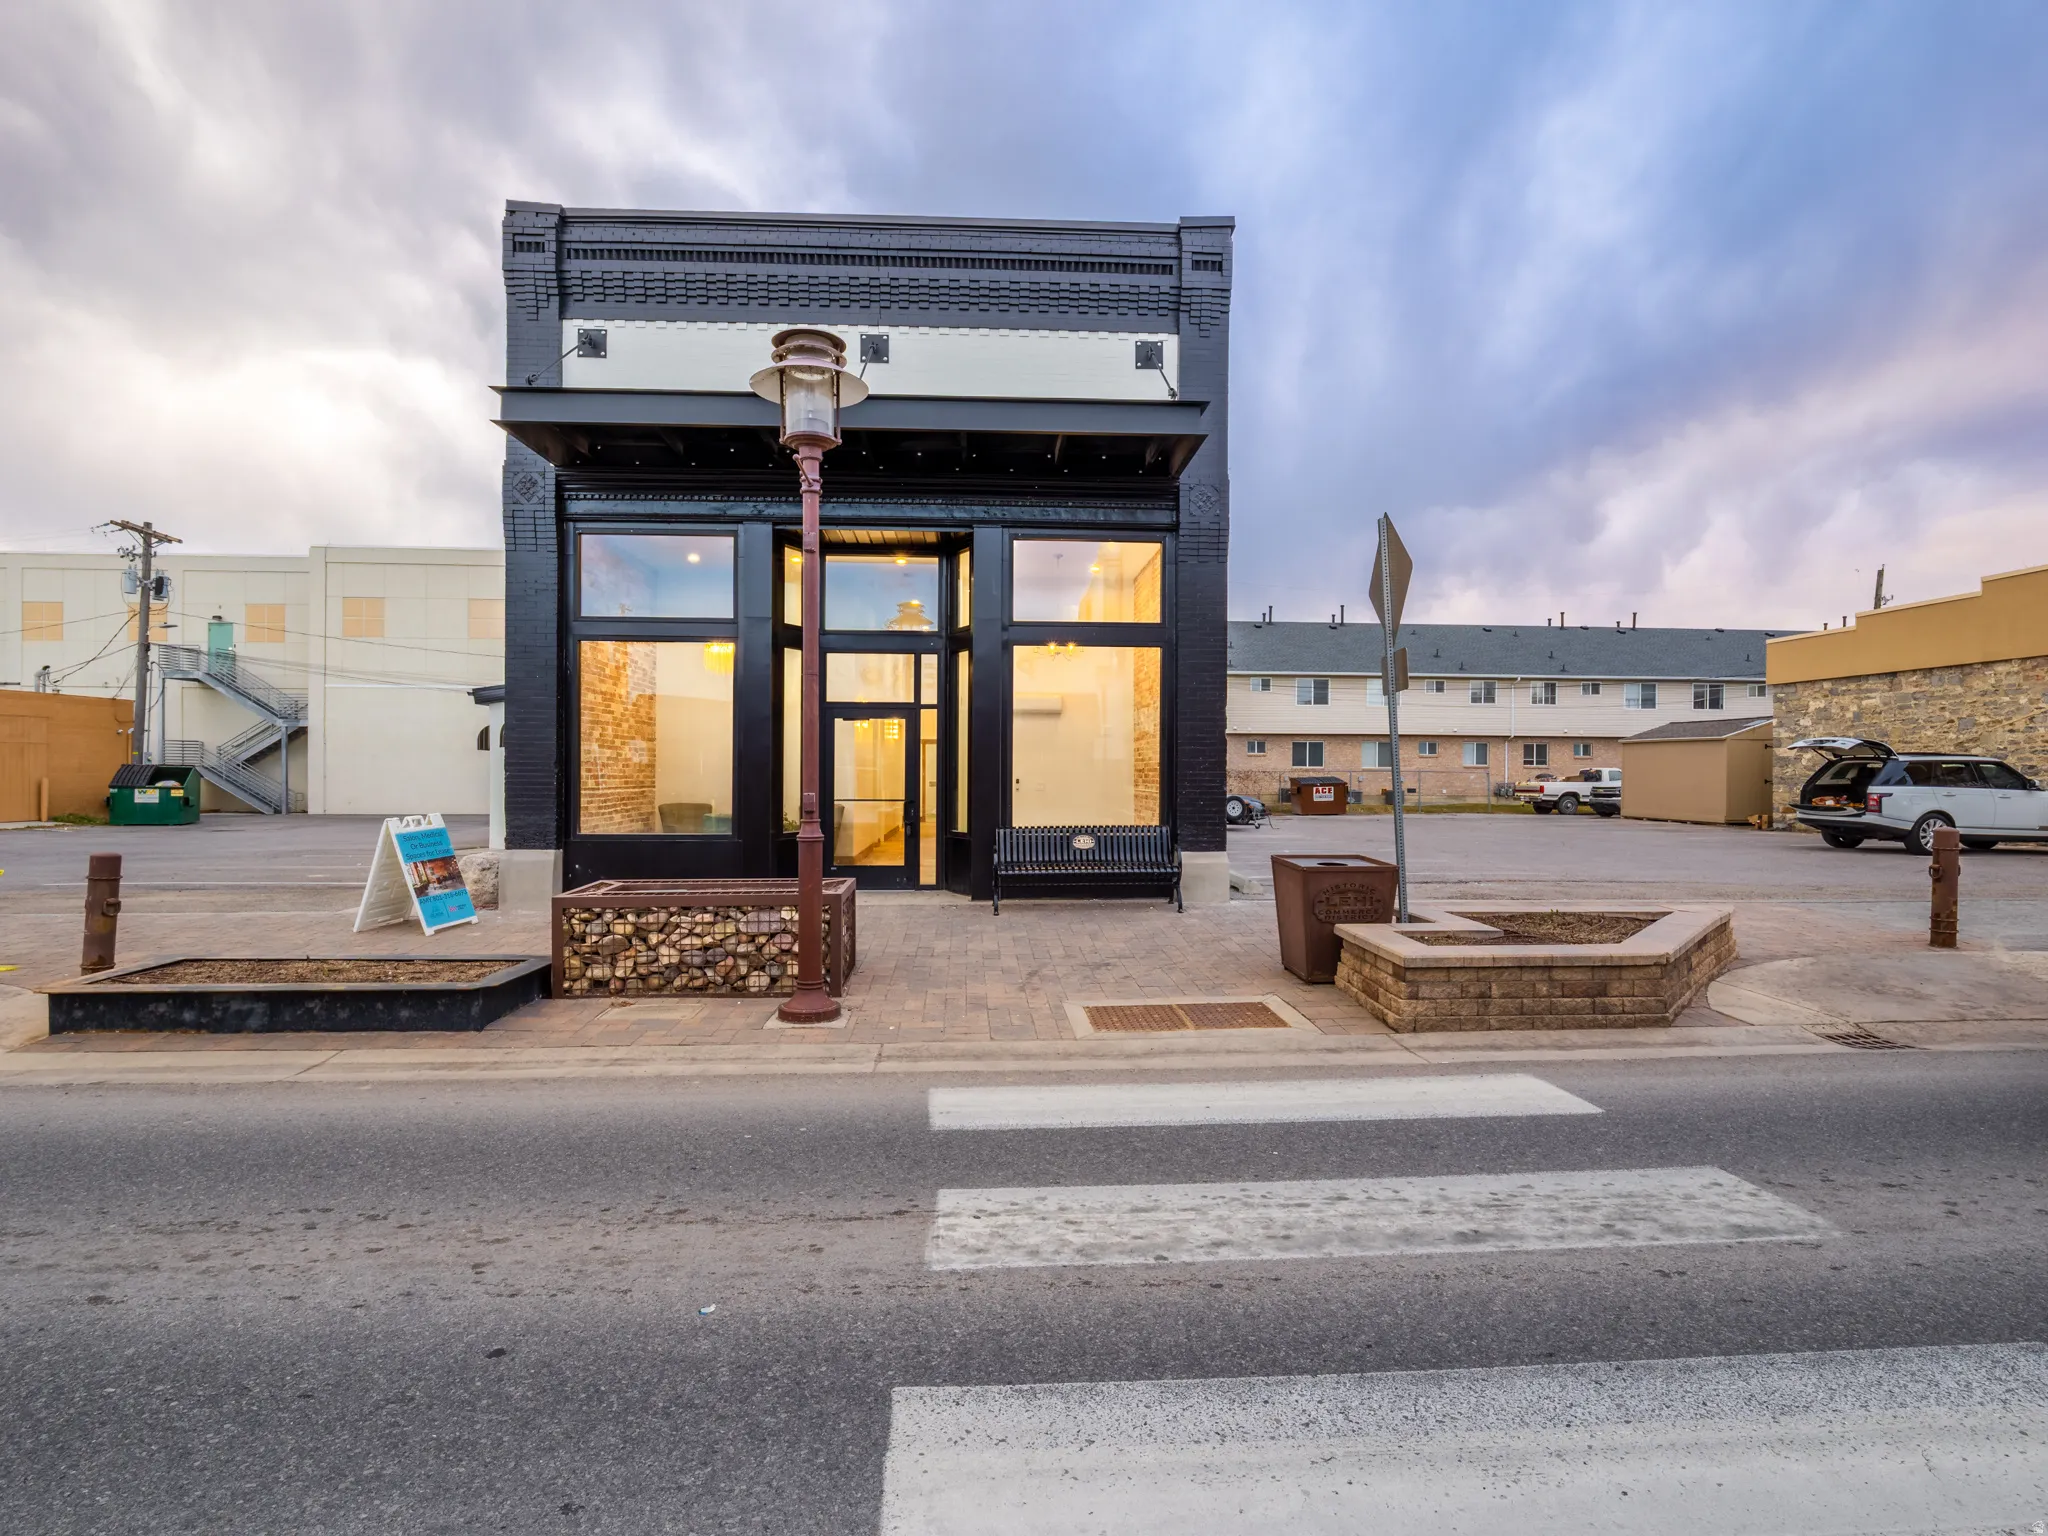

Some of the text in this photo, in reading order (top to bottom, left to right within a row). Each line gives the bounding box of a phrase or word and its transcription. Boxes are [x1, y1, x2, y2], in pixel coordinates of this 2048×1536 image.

[406, 852, 426, 860] Spaces
[1322, 883, 1376, 895] HISTORIC
[419, 897, 432, 905] AMY
[1325, 896, 1373, 907] LEHI
